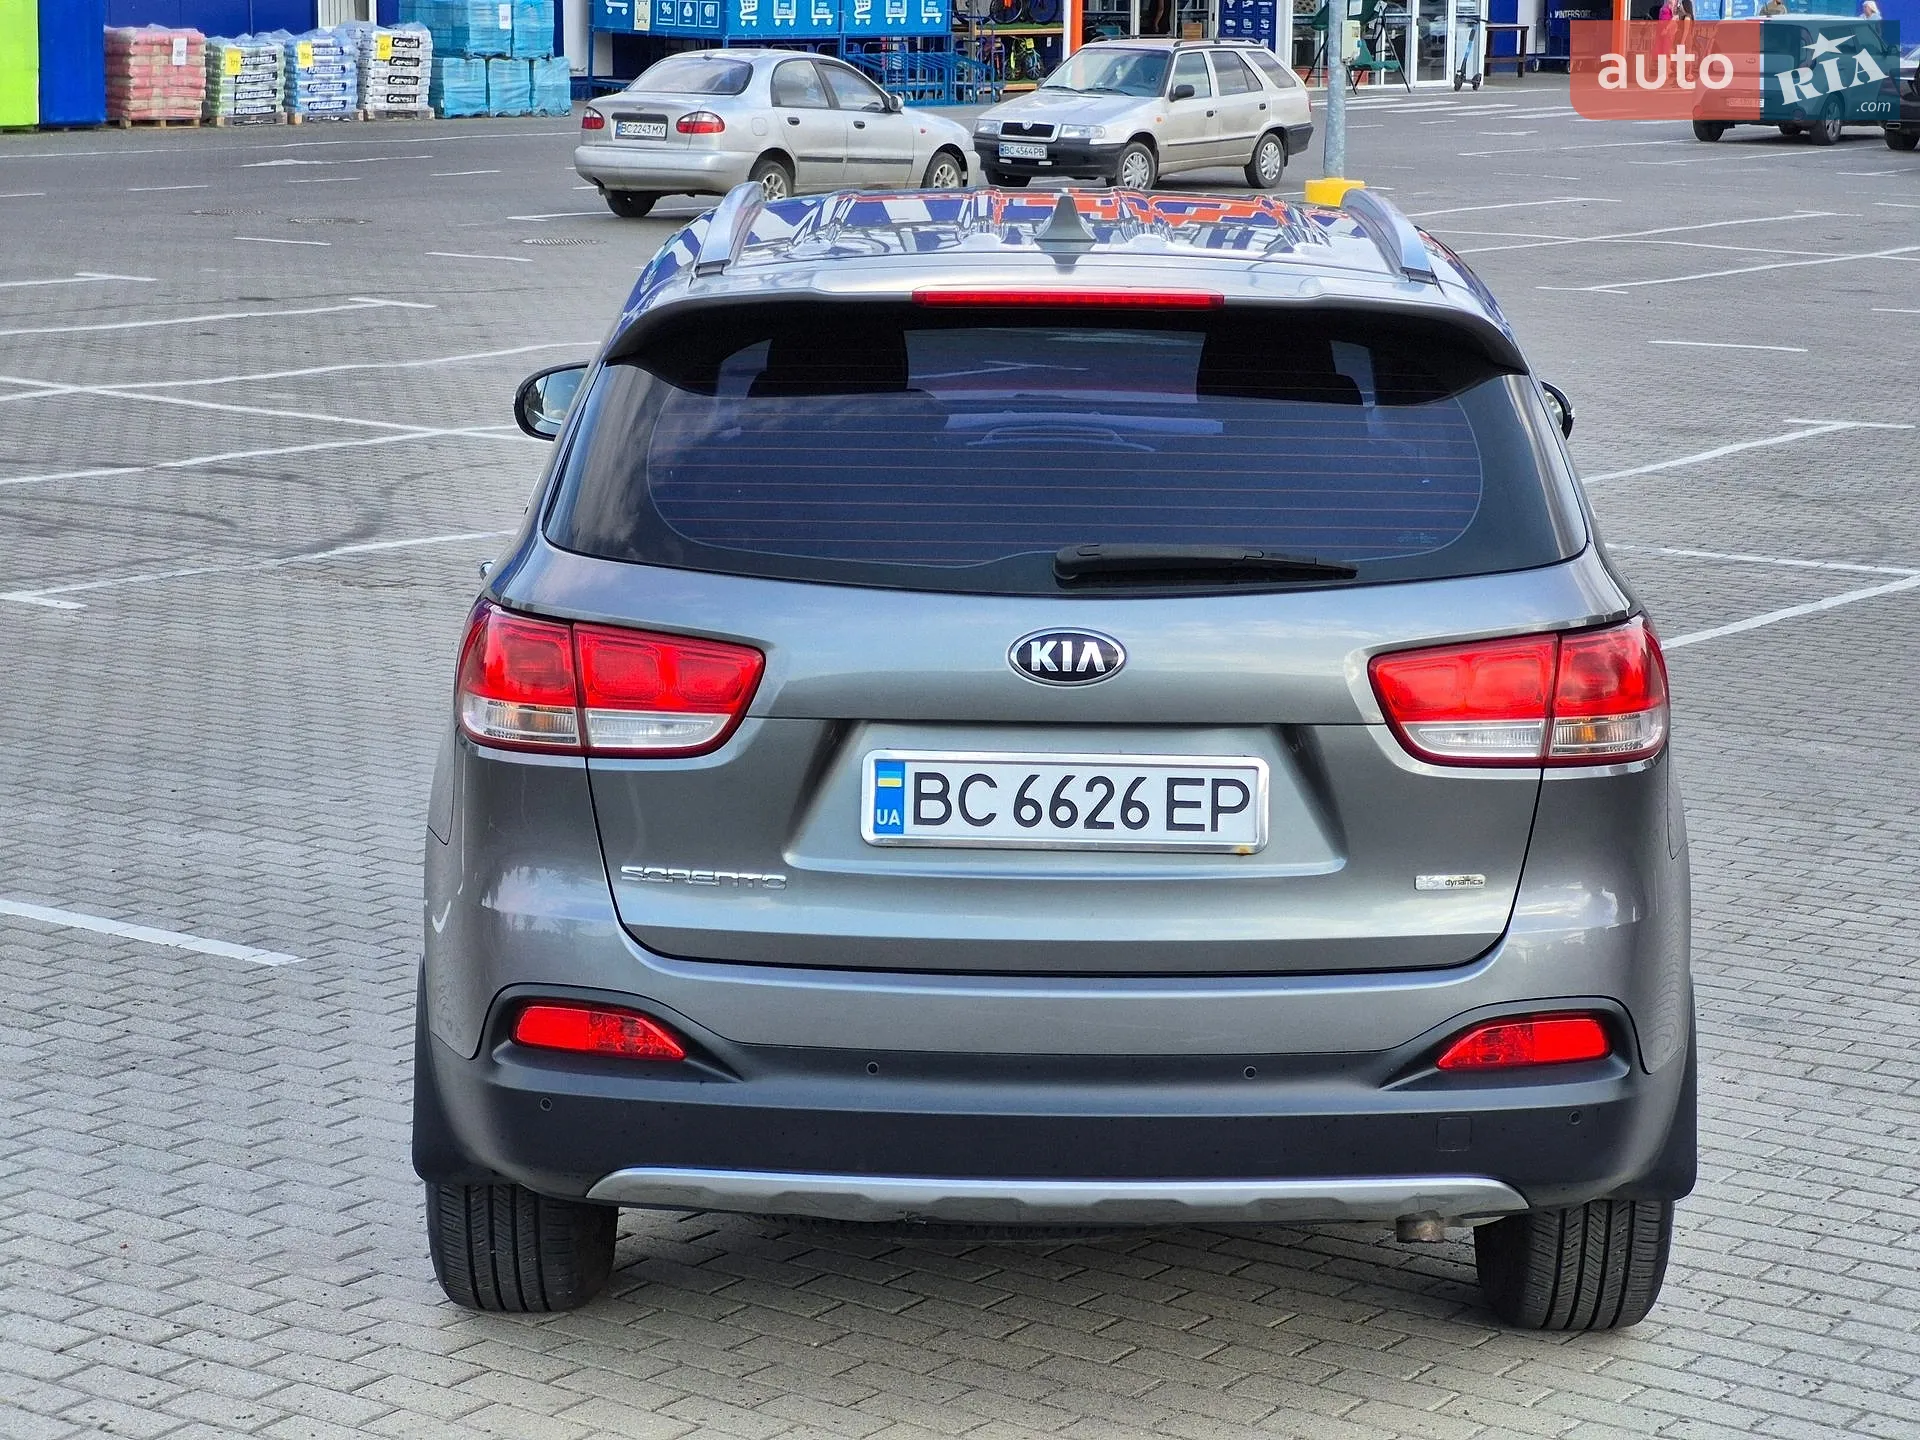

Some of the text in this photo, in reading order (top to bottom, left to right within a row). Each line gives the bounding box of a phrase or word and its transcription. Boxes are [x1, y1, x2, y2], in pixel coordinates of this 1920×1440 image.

[621, 123, 665, 136] BC 2243 MX
[1004, 146, 1015, 155] BC
[1016, 146, 1033, 156] 4564
[1029, 640, 1106, 672] KIA
[913, 772, 1251, 832] BC 6626 EP
[876, 809, 900, 826] UA
[620, 865, 788, 891] SORENTO
